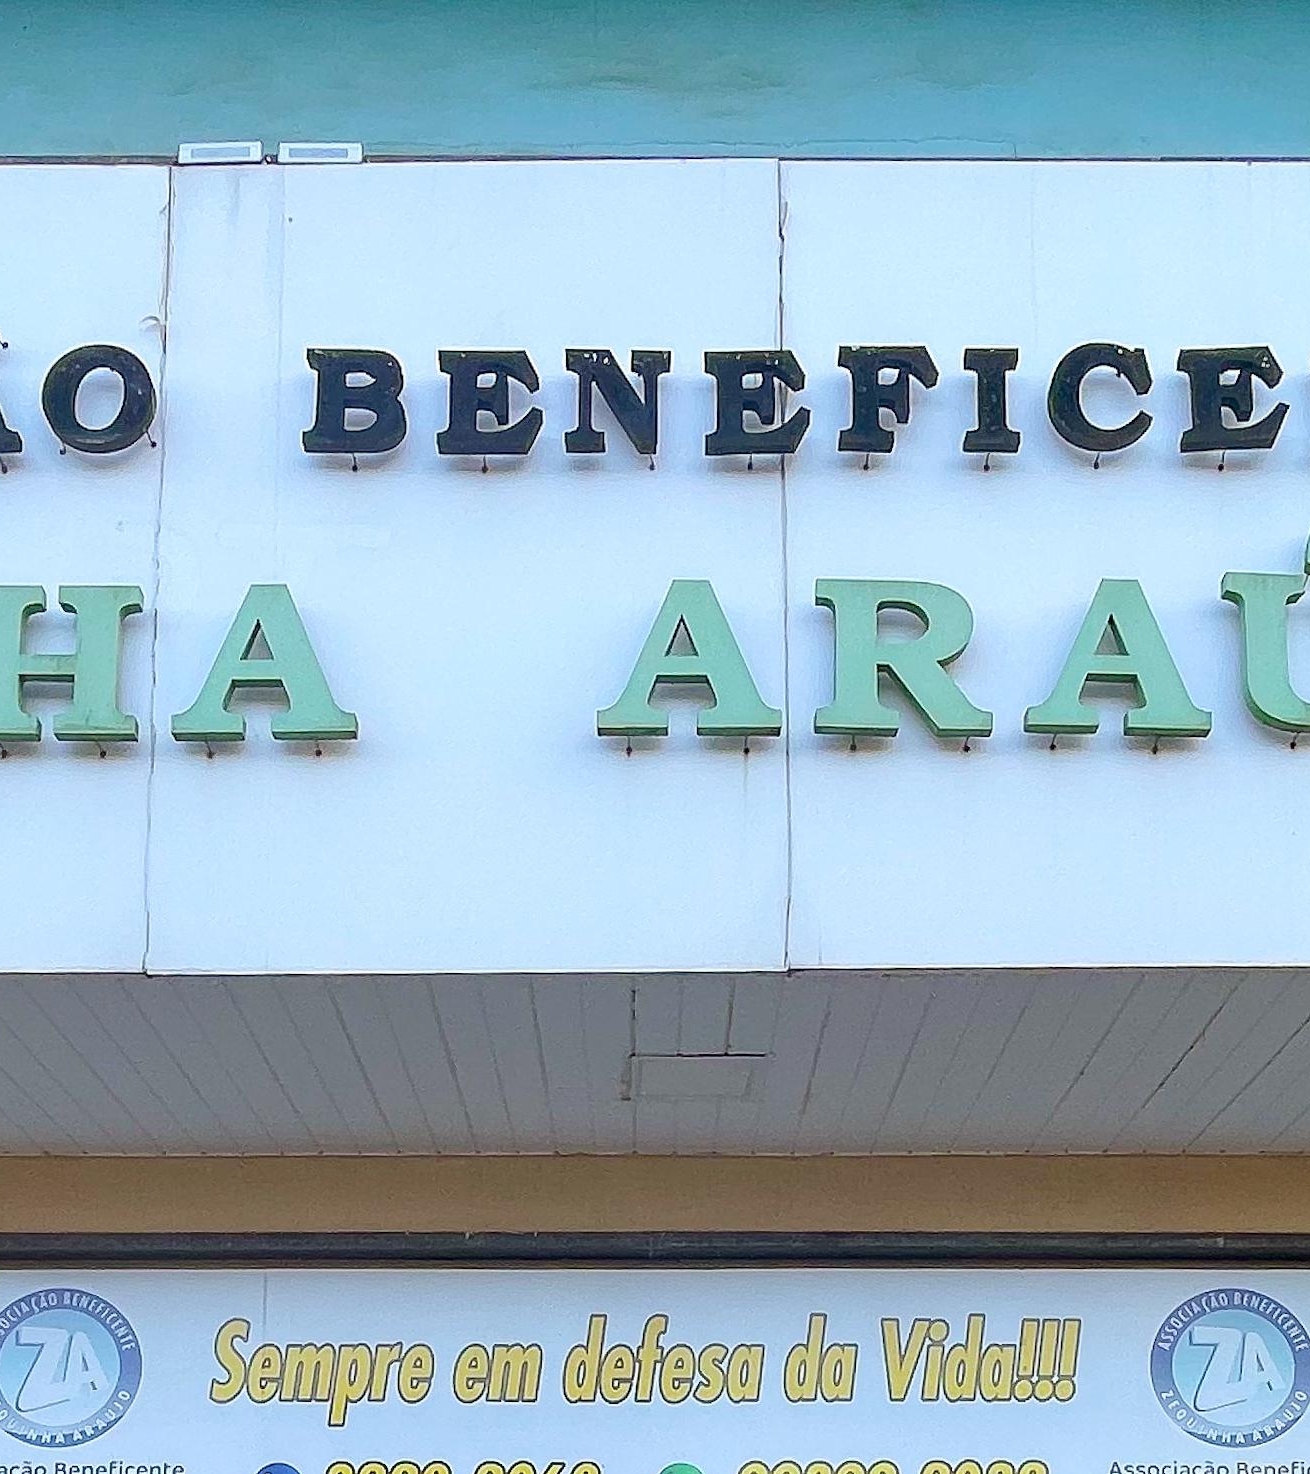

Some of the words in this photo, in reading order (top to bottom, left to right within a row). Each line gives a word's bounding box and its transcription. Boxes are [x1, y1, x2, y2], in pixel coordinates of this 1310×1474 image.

[63, 1291, 136, 1351] BENEFICENTE
[1157, 1292, 1229, 1351] ASSOCIAÇÃO
[1234, 1291, 1310, 1351] BENEFICENTE
[15, 1327, 110, 1413] ZA
[209, 1319, 434, 1426] Sempre
[452, 1342, 545, 1402] em
[562, 1314, 764, 1402] defesa
[784, 1313, 859, 1402] da
[881, 1313, 1083, 1402] Vida!!!
[1189, 1326, 1287, 1412] ZA
[1161, 1389, 1246, 1443] ZEQUINHA
